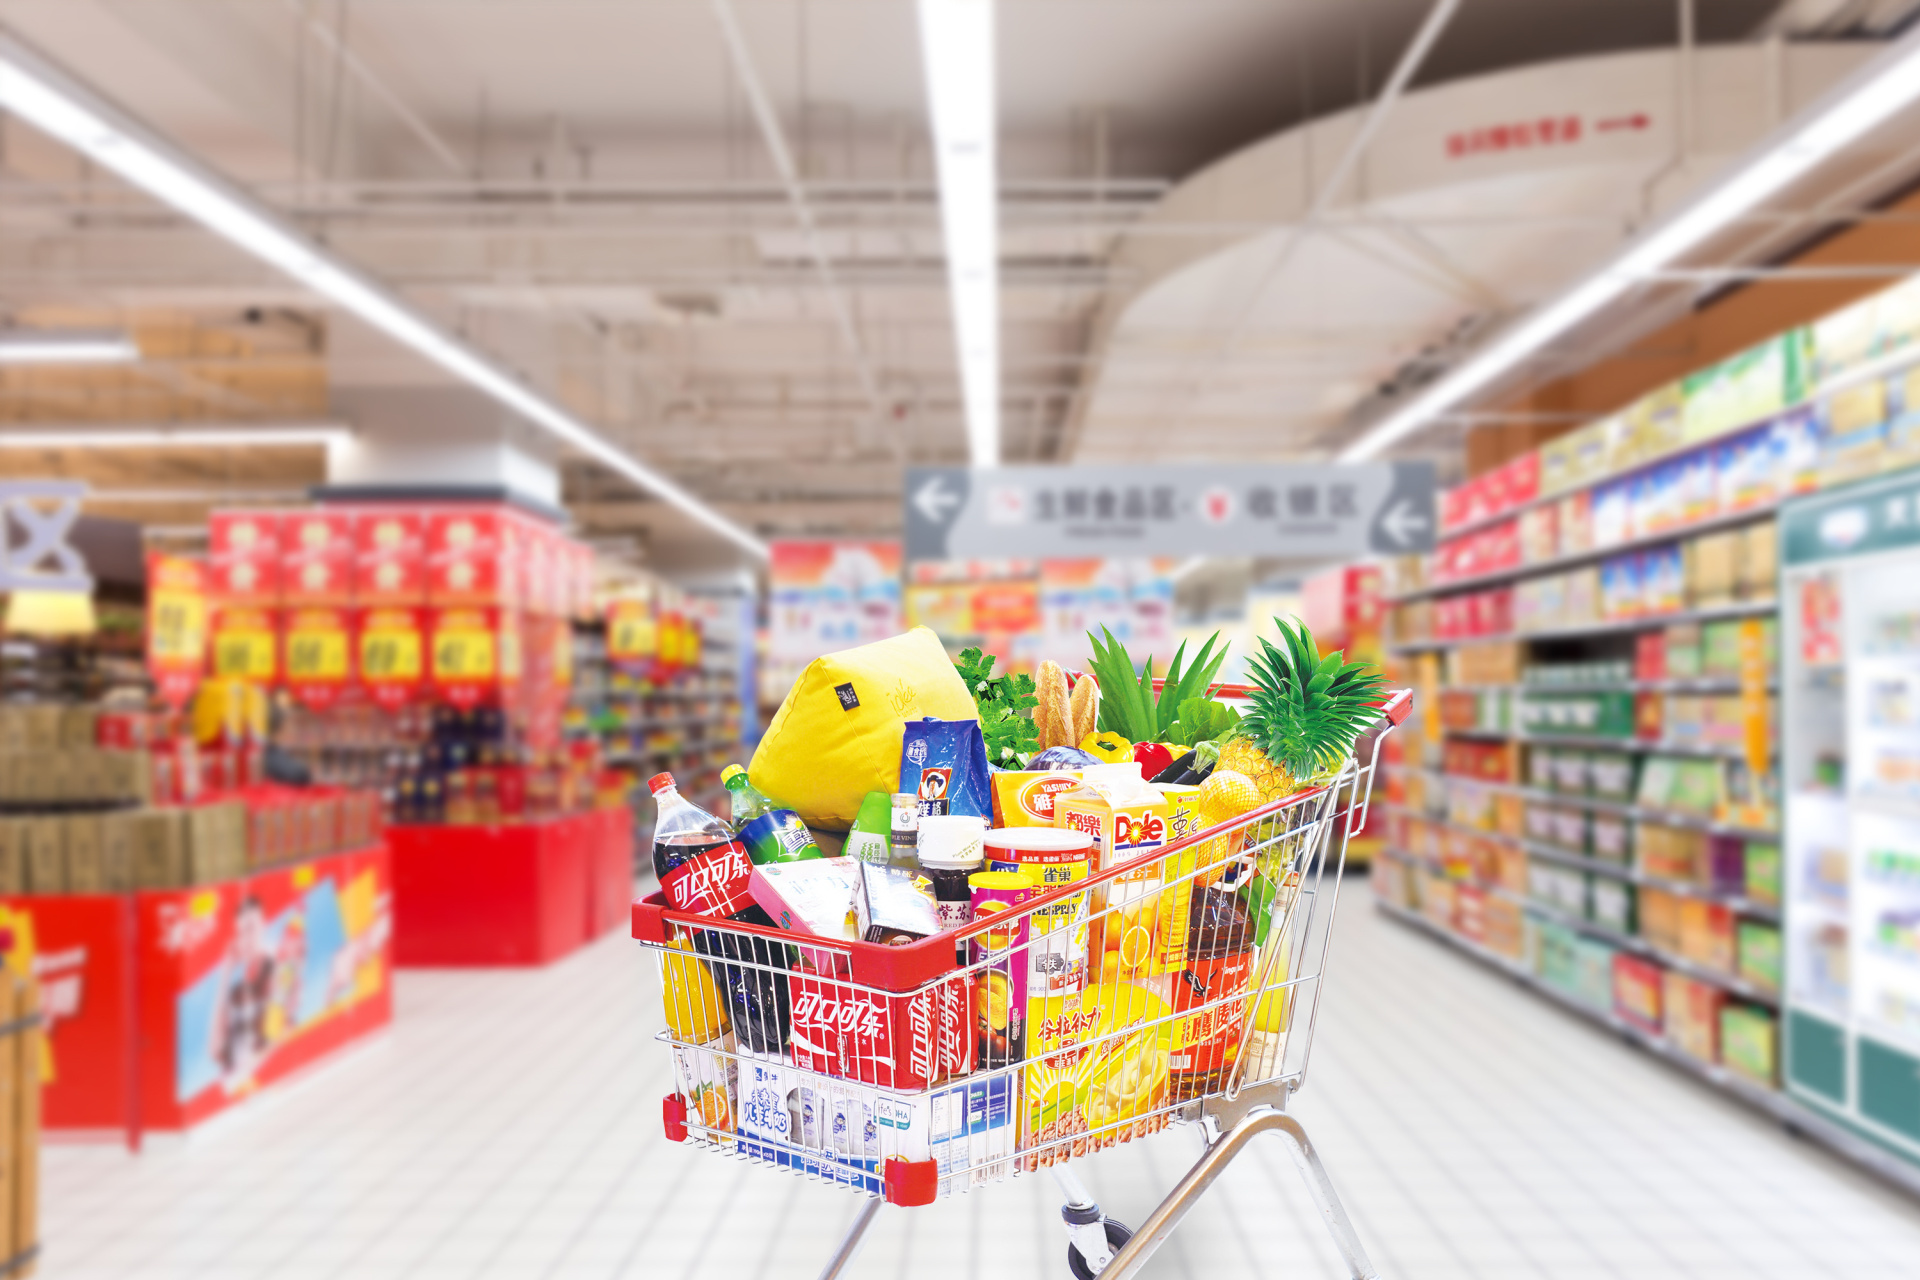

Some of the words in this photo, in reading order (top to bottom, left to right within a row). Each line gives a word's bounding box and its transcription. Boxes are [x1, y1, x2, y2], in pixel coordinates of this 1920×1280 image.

[1114, 812, 1164, 846] Dole
[671, 849, 750, 909] 可口可乐
[793, 990, 887, 1038] 可口可乐
[908, 993, 932, 1079] 可口可乐
[1037, 1006, 1102, 1041] 谷粒谷力
